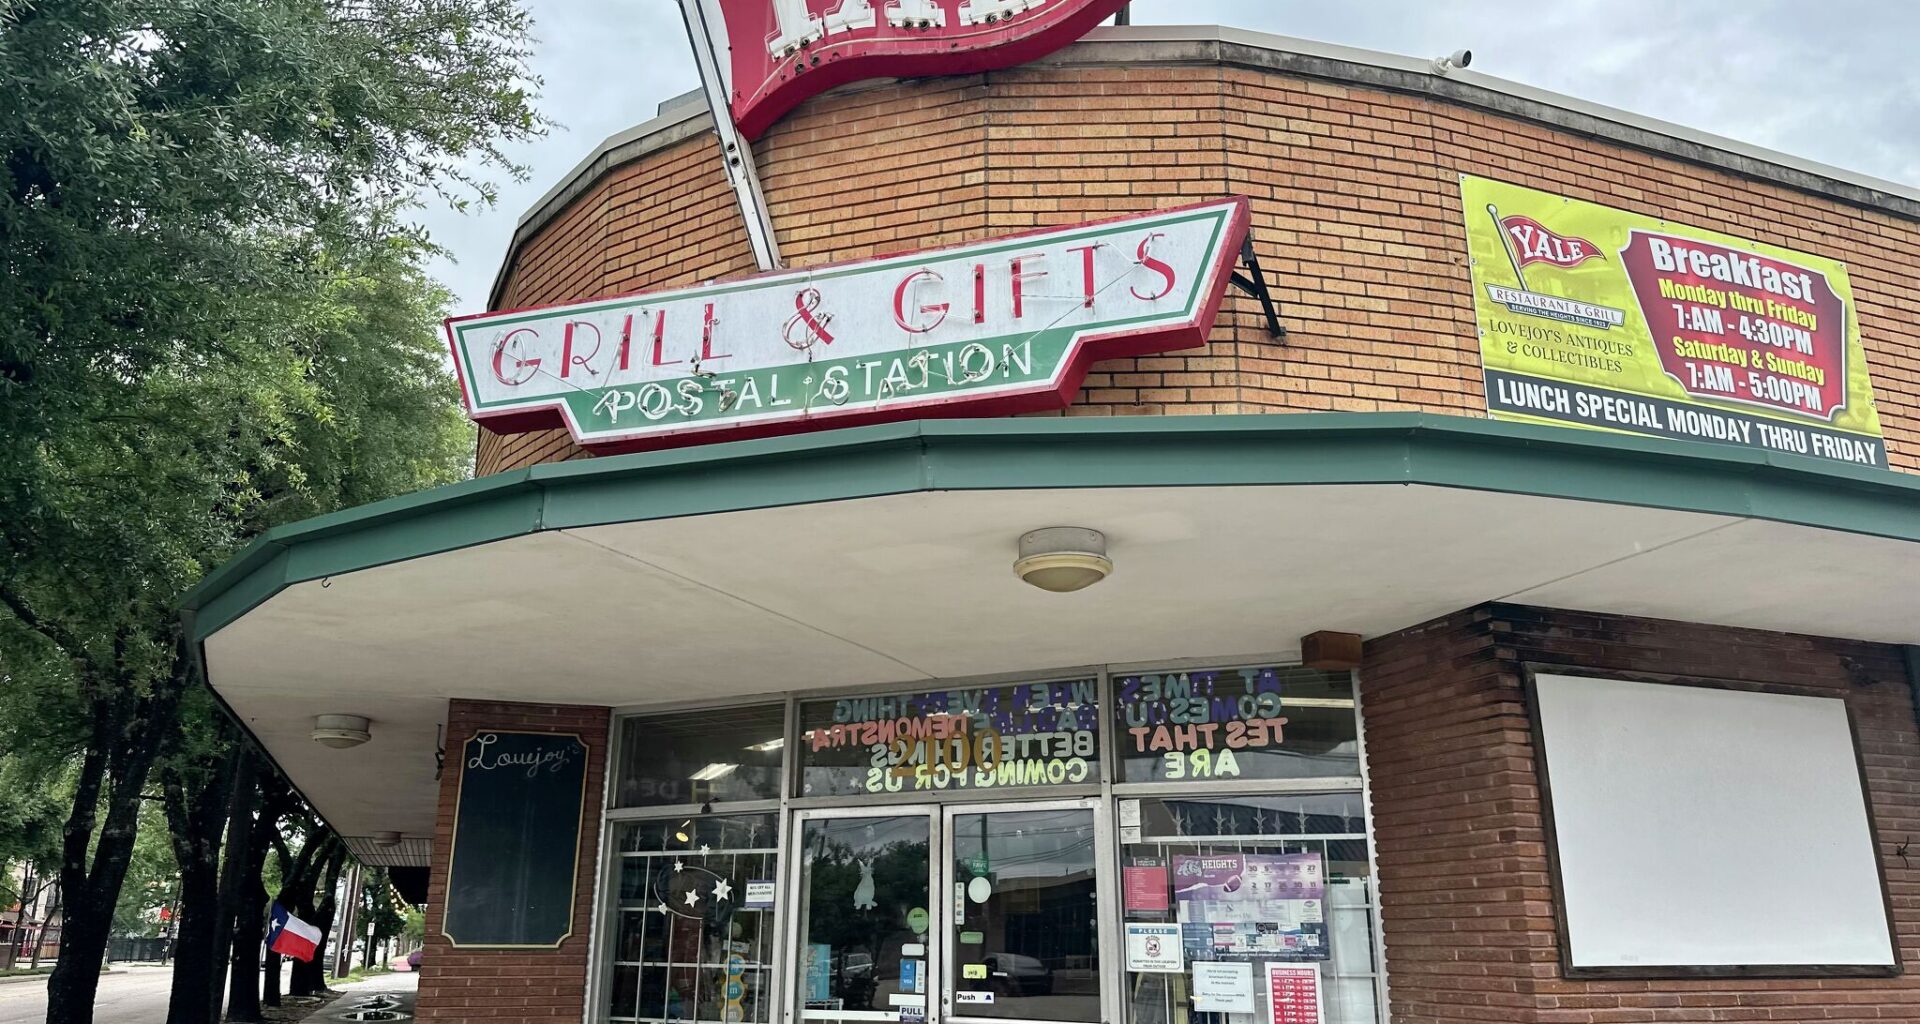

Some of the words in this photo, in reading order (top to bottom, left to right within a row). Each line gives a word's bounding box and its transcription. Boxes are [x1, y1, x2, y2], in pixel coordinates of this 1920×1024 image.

[1510, 225, 1584, 262] YALE
[1648, 237, 1816, 304] Breakfast
[491, 303, 733, 386] GRILL
[781, 287, 835, 350] &
[893, 232, 1177, 334] GIFTS
[1496, 290, 1570, 311] RESTAURANT
[1574, 304, 1582, 314] &
[1585, 307, 1617, 322] GRILL
[1511, 304, 1537, 314] SERVING
[1538, 308, 1549, 317] THE
[1550, 310, 1575, 321] HEIGHTS
[1576, 315, 1593, 325] SINCE
[1658, 278, 1727, 310] Monday
[1729, 291, 1765, 316] thru
[1766, 299, 1817, 331] Friday
[1490, 319, 1562, 343] LOVEJOY'S
[1566, 333, 1633, 356] ANTIQUES
[1672, 304, 1725, 335] 7:AM
[1739, 315, 1813, 355] 4:30PM
[1507, 341, 1518, 353] &
[1522, 345, 1623, 372] COLLECTIBLES
[1673, 336, 1747, 368] Saturday
[1751, 350, 1764, 369] &
[1766, 352, 1825, 386] Sunday
[594, 373, 792, 424] POSTAL
[822, 341, 1031, 405] STATION
[1686, 362, 1736, 393] 7:AM
[1748, 372, 1822, 411] 5:00PM
[1497, 379, 1571, 414] LUNCH
[1577, 393, 1663, 430] SPECIAL
[1667, 407, 1753, 444] MONDAY
[1756, 422, 1807, 454] THRU
[1811, 433, 1877, 465] FRIDAY
[468, 734, 581, 779] Lovejoy's
[889, 728, 1002, 777] 2100
[1202, 859, 1238, 869] HEIGHTS
[901, 1007, 922, 1015] PULL
[957, 993, 976, 1001] Push
